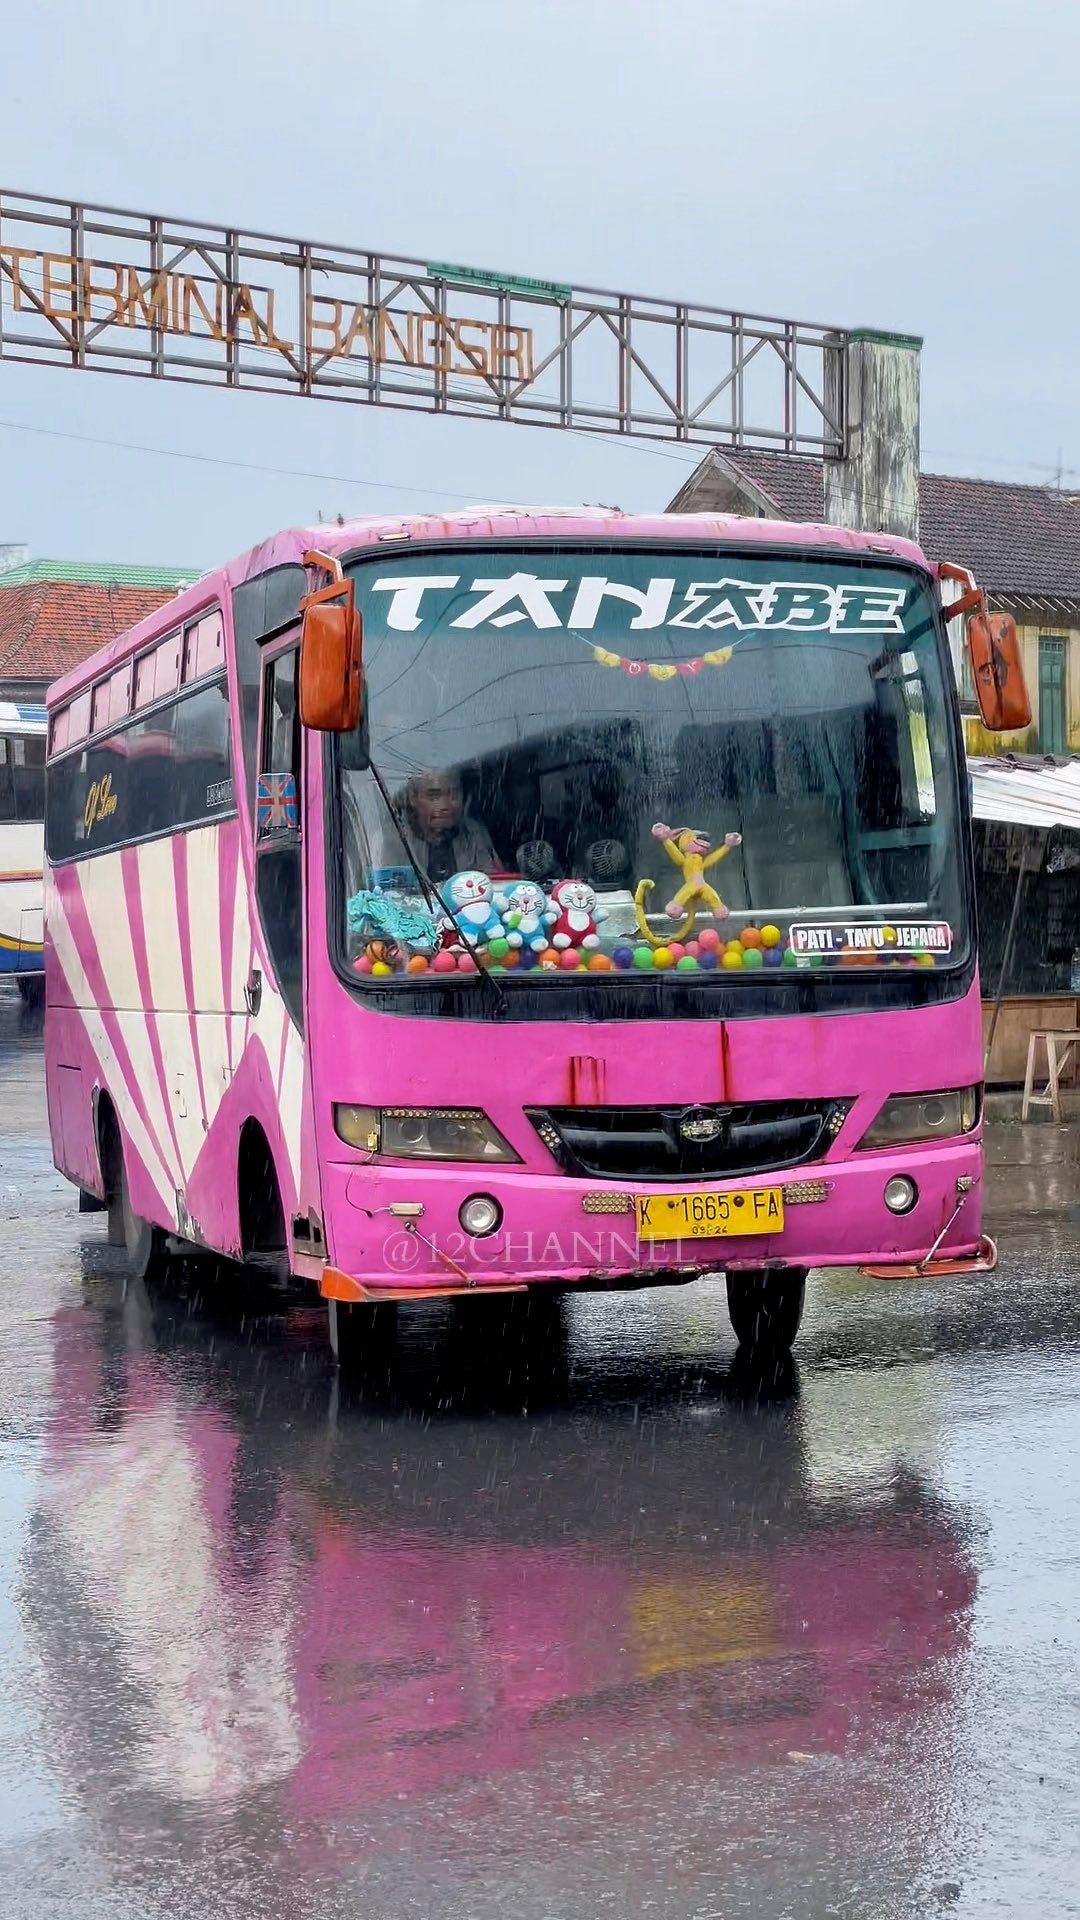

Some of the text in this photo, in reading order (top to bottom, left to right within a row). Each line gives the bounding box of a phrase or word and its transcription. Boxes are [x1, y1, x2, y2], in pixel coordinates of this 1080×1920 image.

[0, 246, 534, 384] TERMINAL BANGSRI
[370, 572, 906, 633] TANABE
[796, 929, 833, 949] PATI
[845, 927, 884, 948] TAYU
[897, 927, 946, 947] JEPARA
[640, 1191, 779, 1226] K 1665 FA
